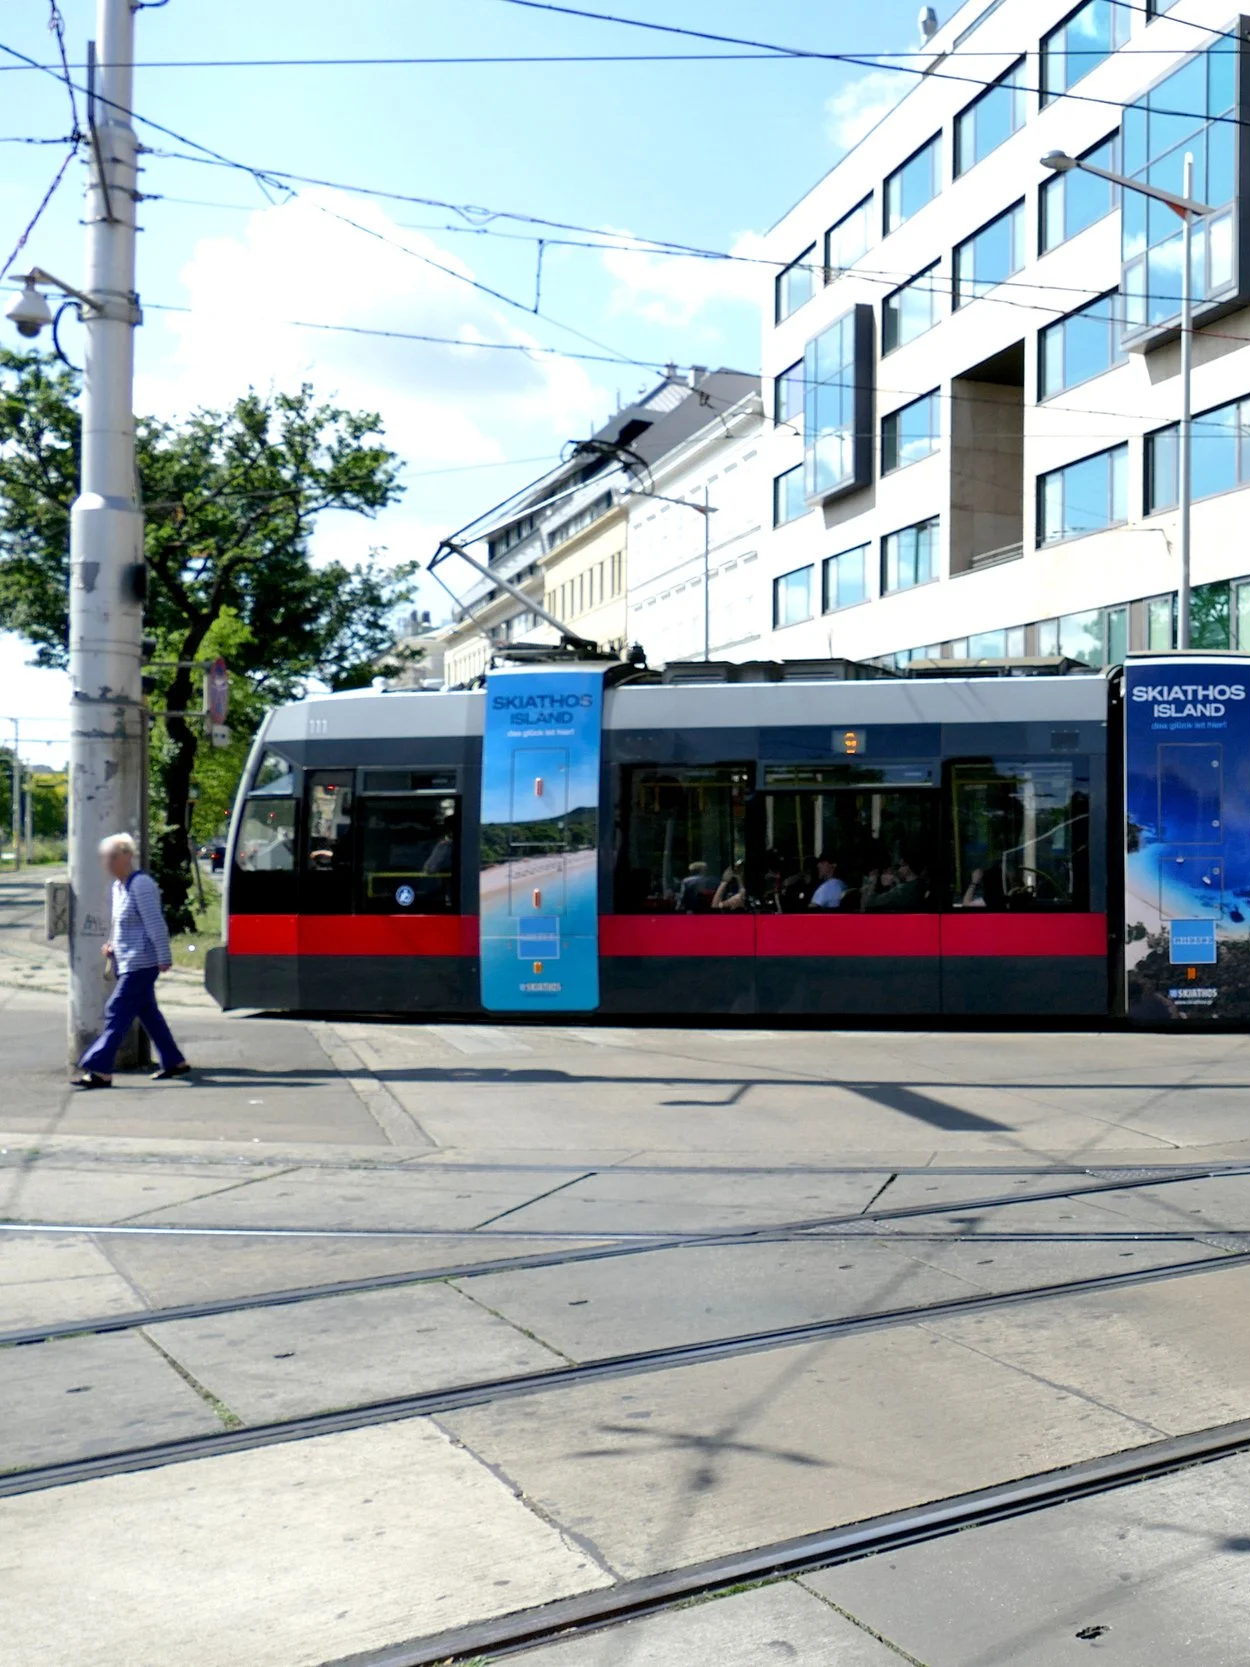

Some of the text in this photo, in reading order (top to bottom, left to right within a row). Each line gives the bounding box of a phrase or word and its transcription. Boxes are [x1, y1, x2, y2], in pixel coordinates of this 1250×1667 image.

[1132, 684, 1246, 702] SKIATHOS
[491, 694, 593, 710] SKIATHOS
[1153, 703, 1226, 718] ISLAND
[510, 711, 573, 726] ISLAND
